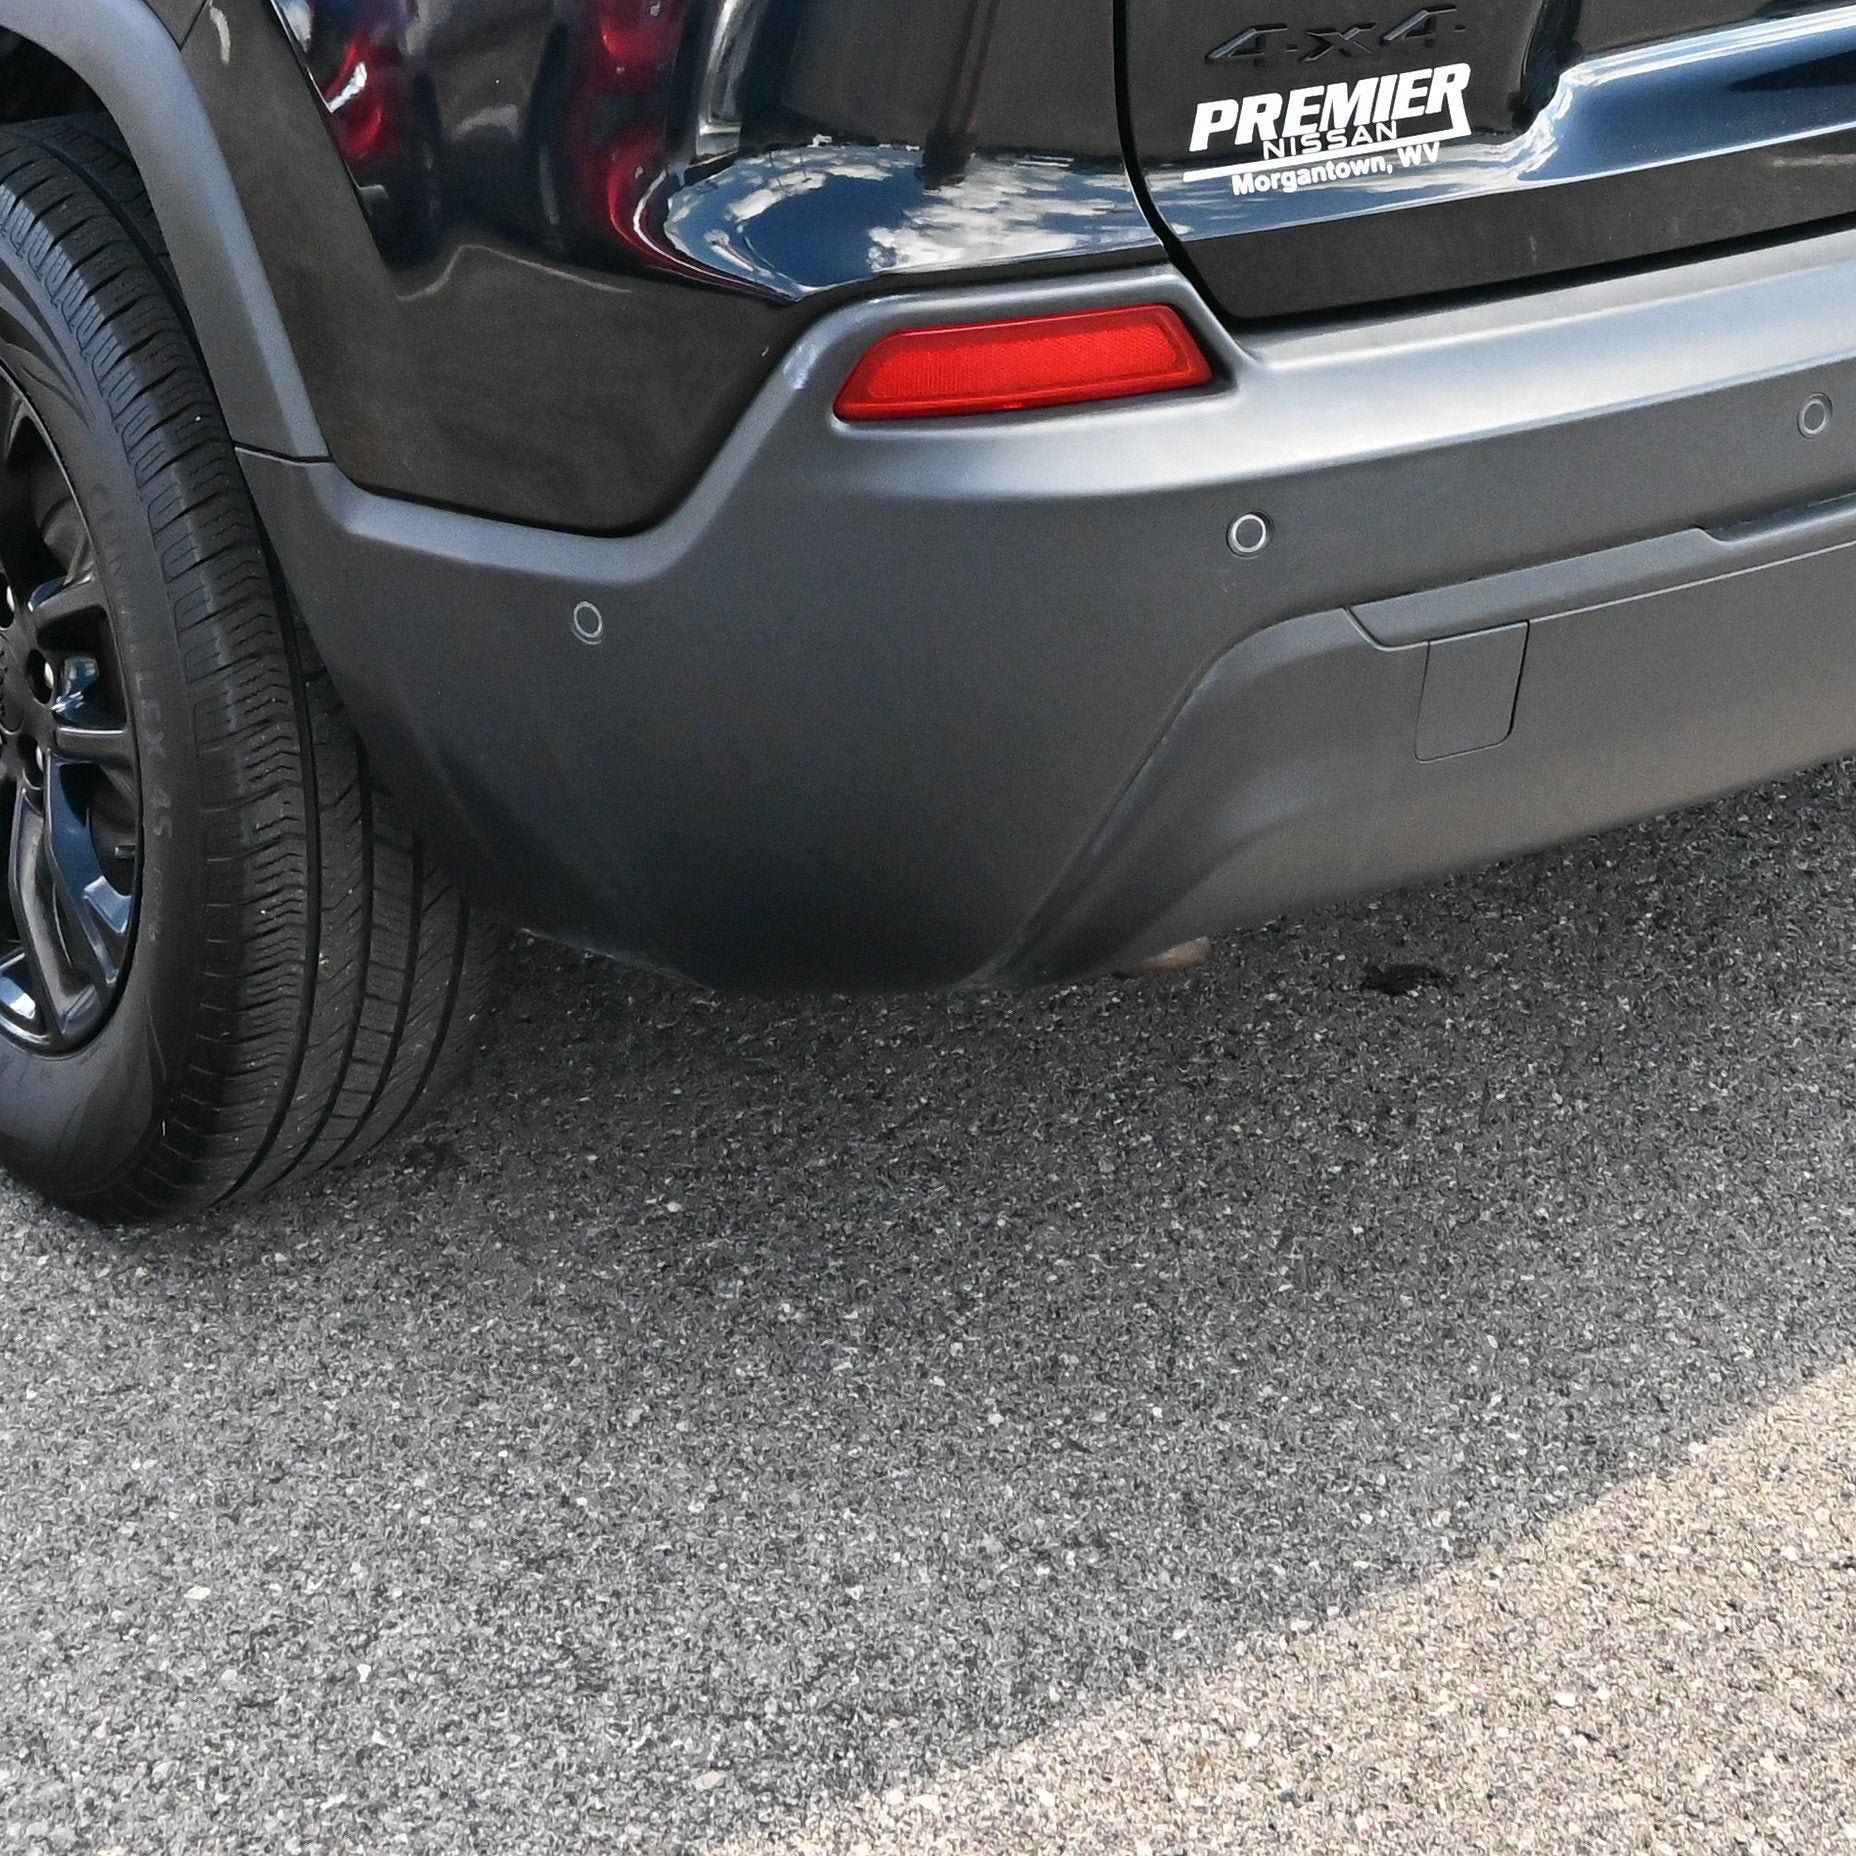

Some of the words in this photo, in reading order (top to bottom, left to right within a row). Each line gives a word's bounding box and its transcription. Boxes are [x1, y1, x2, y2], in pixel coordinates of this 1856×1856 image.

[1187, 62, 1472, 153] PREMIER
[1262, 120, 1398, 160] NISSAN
[1231, 157, 1394, 197] Morgantown,
[1397, 141, 1442, 168] WV
